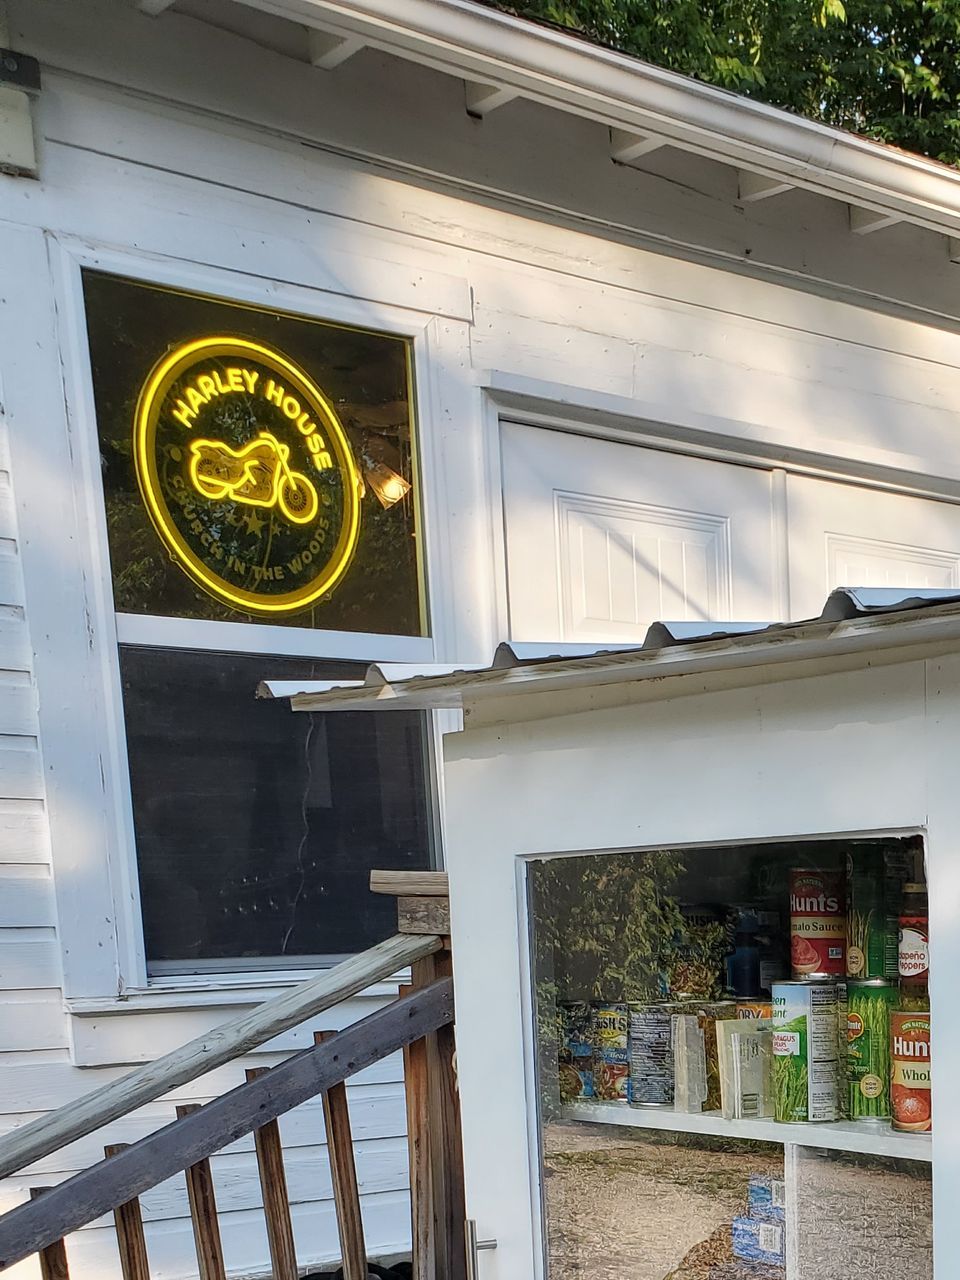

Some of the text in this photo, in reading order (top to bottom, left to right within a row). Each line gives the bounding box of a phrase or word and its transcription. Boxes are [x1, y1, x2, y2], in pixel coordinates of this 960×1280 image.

[172, 368, 333, 471] HARLEY HOUSE
[226, 555, 246, 575] IN
[250, 565, 285, 580] THE
[287, 517, 330, 574] WOODS
[812, 922, 843, 931] Sauce
[772, 997, 786, 1006] een
[739, 1008, 763, 1019] ORY
[772, 1009, 786, 1018] ant
[597, 1017, 627, 1032] USH'S
[894, 1035, 931, 1056] Hun
[902, 1068, 931, 1081] Whol
